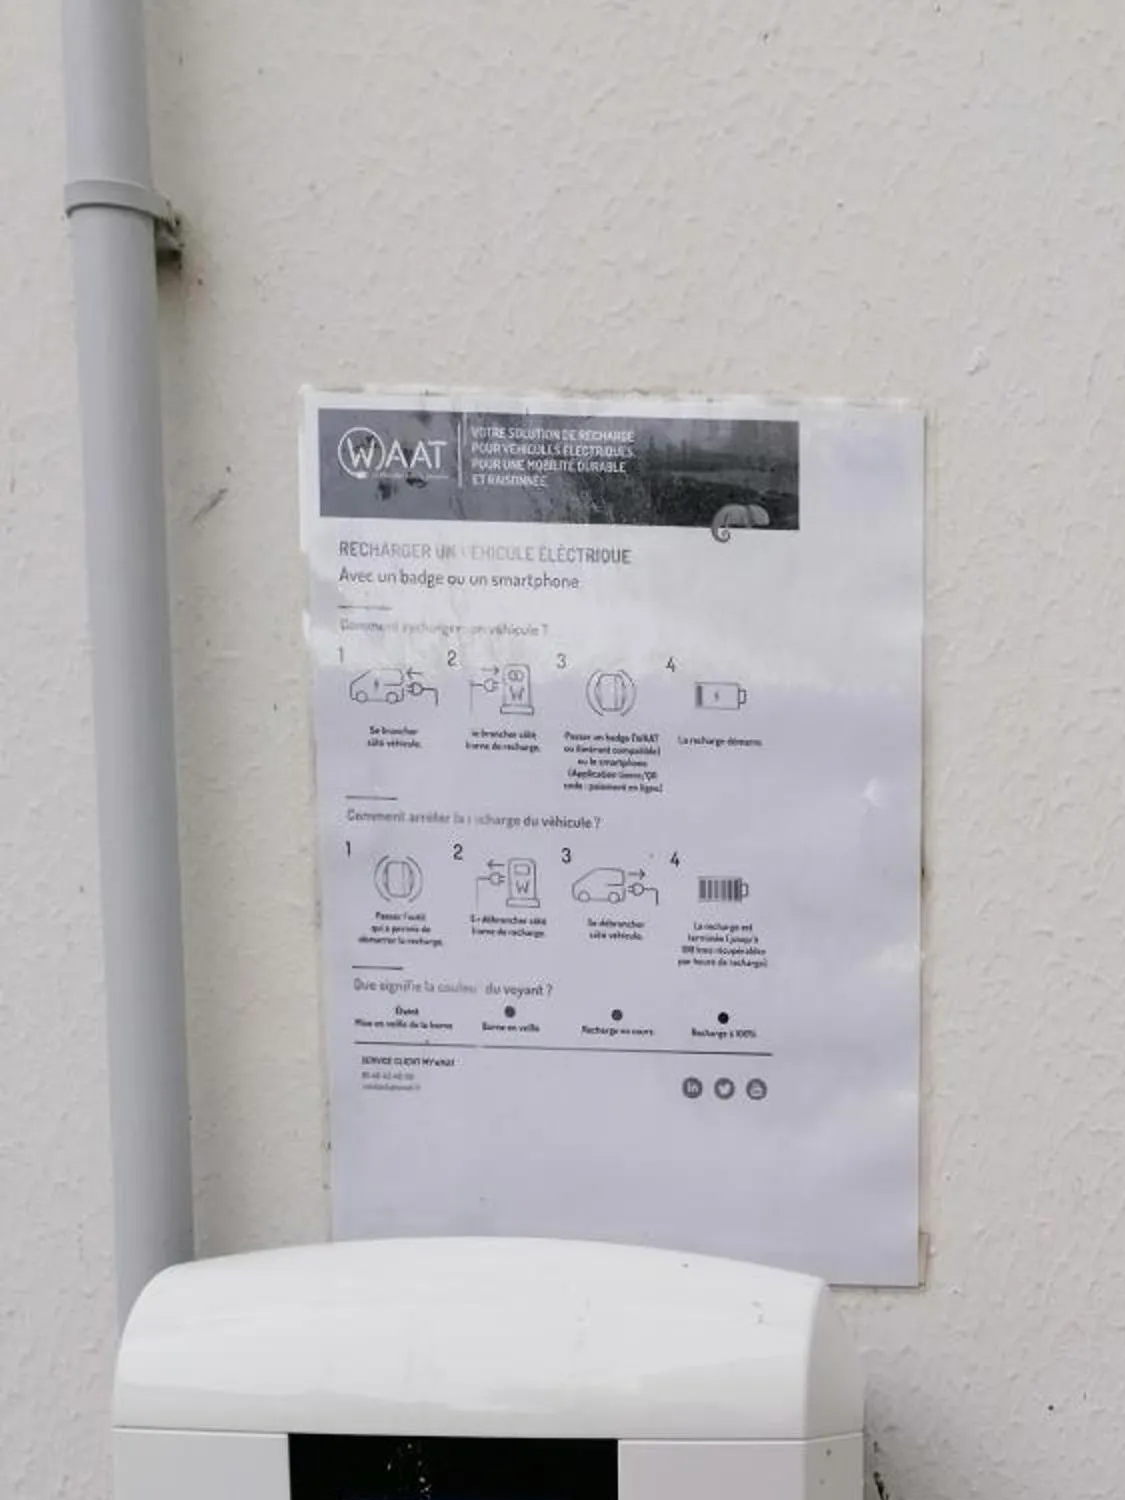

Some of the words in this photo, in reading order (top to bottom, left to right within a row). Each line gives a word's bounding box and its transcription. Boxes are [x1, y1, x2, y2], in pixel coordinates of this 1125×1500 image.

[346, 437, 448, 470] WAAT
[339, 541, 431, 559] RECHARGER
[436, 544, 456, 560] UN
[339, 567, 373, 583] Avec
[377, 573, 397, 583] un
[400, 568, 444, 589] badge
[447, 574, 465, 584] ou
[469, 575, 488, 586] un
[491, 573, 580, 590] smartphone
[338, 647, 344, 663] 1
[447, 650, 457, 666] 2
[556, 653, 567, 669] 3
[665, 656, 675, 672] 4
[347, 809, 405, 822] Comment
[523, 815, 539, 827] du
[345, 841, 351, 856] 1
[452, 843, 463, 861] 2
[560, 847, 571, 864] 3
[669, 852, 680, 868] 4
[354, 978, 377, 991] Que
[380, 980, 422, 995] signifie
[424, 981, 435, 992] la
[485, 983, 500, 995] du
[503, 984, 544, 998] voyant
